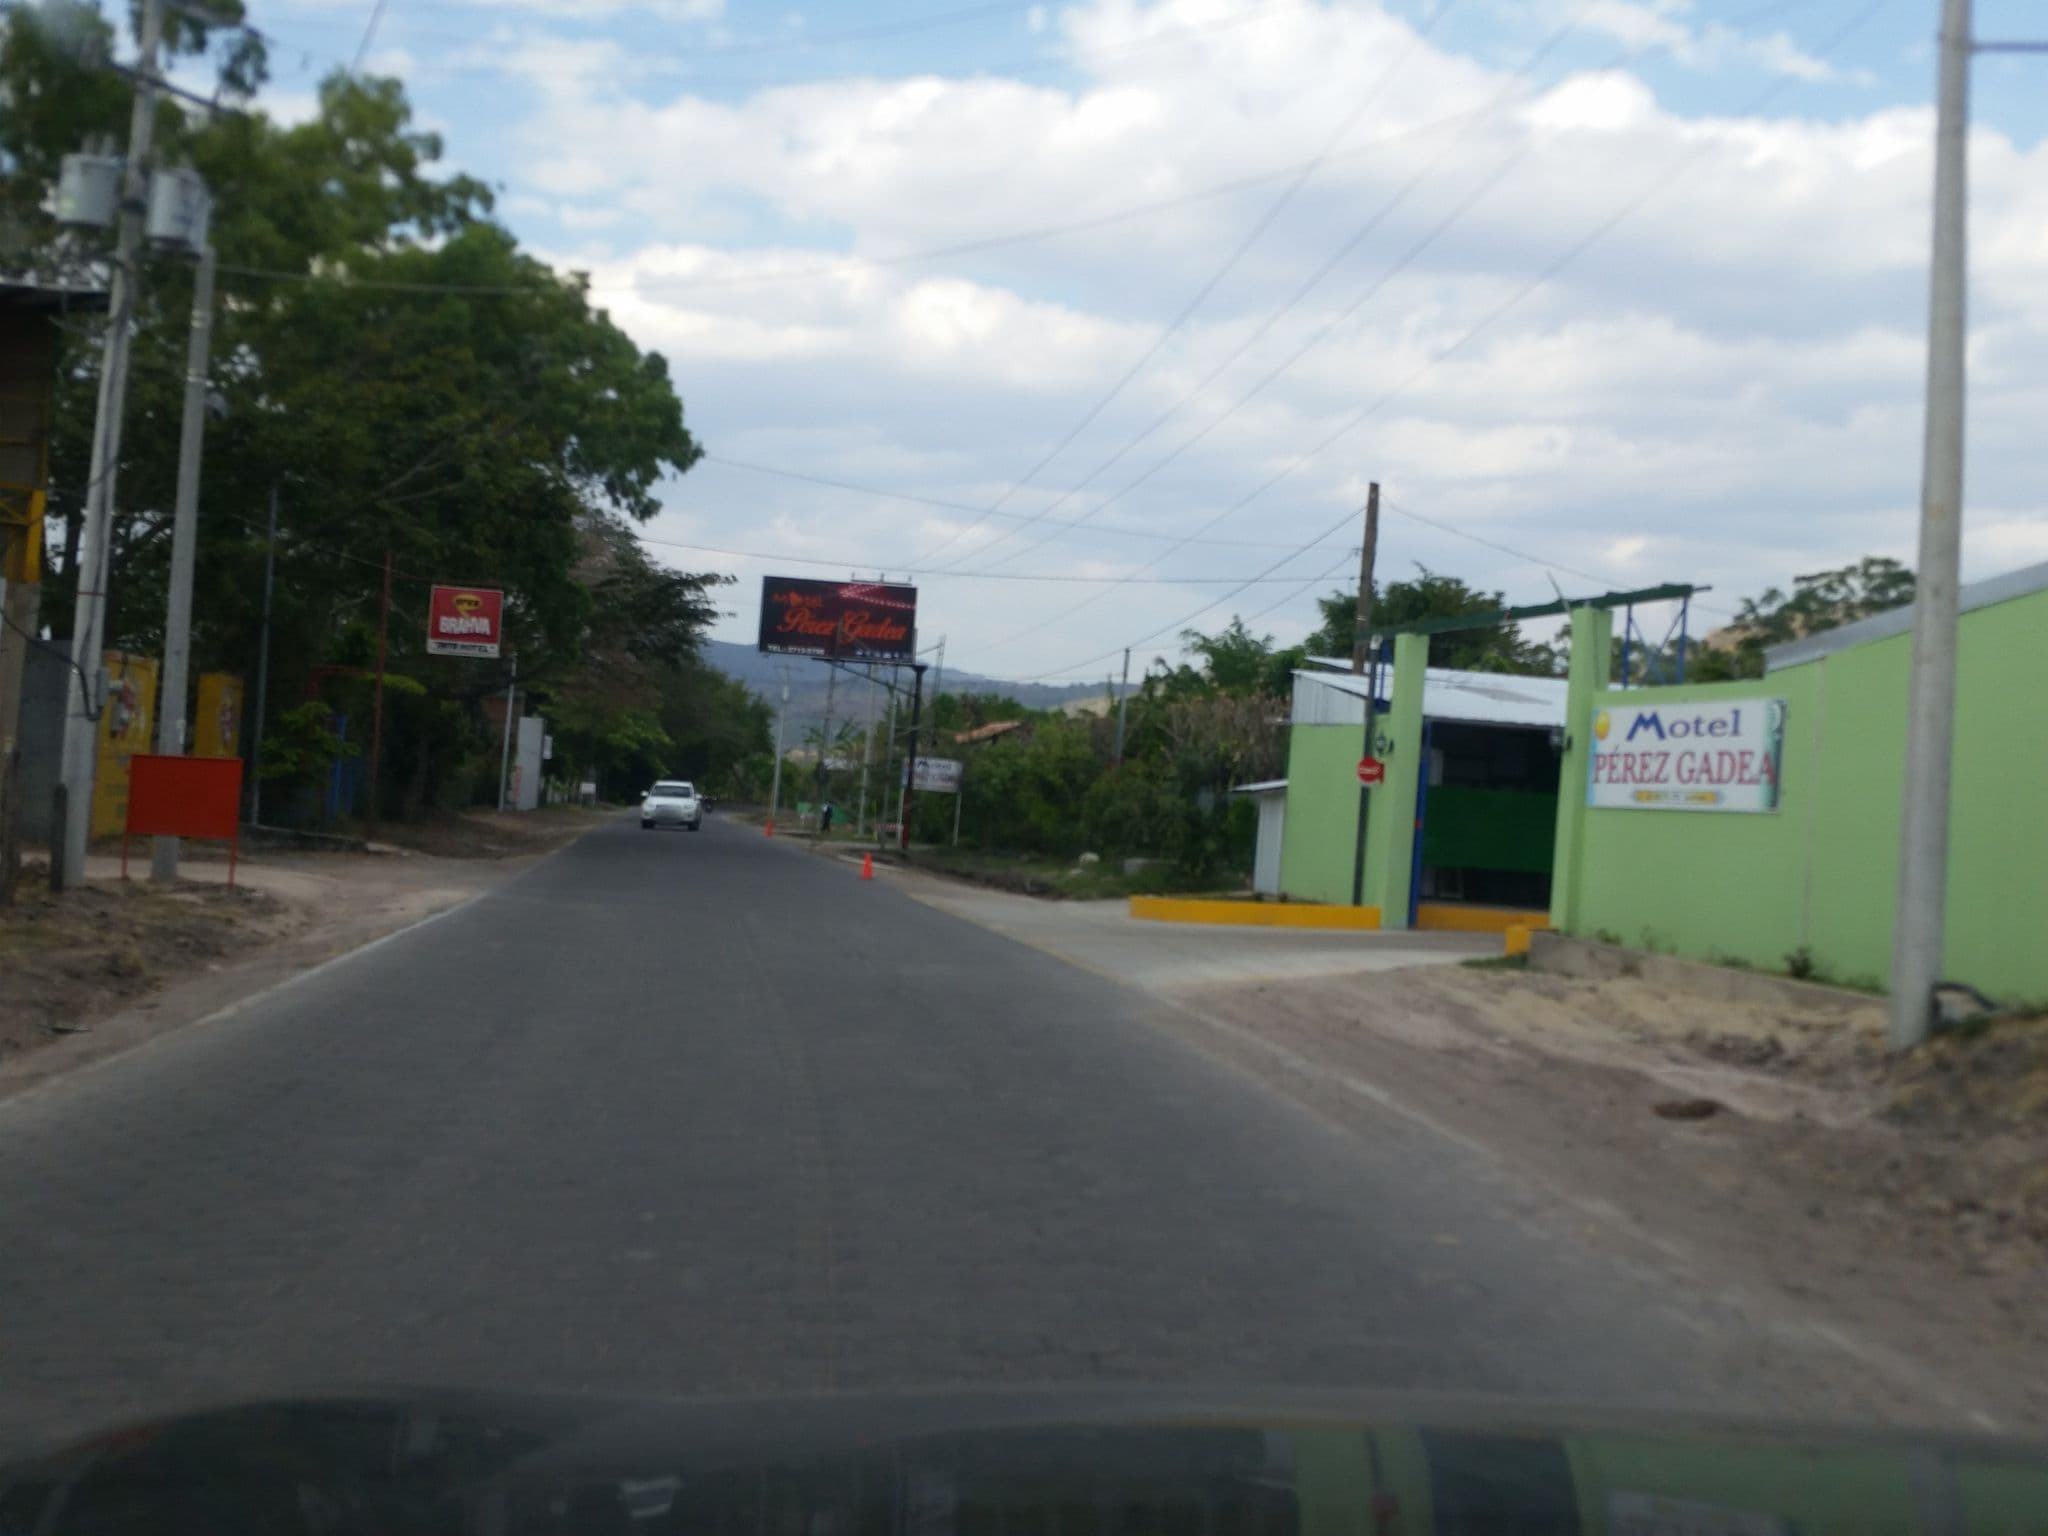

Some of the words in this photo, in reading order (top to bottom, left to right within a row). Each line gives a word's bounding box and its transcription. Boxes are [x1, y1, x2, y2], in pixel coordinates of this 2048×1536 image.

[1626, 708, 1743, 742] Motel
[1592, 745, 1671, 785] PÉREZ
[1676, 750, 1777, 785] GADEA
